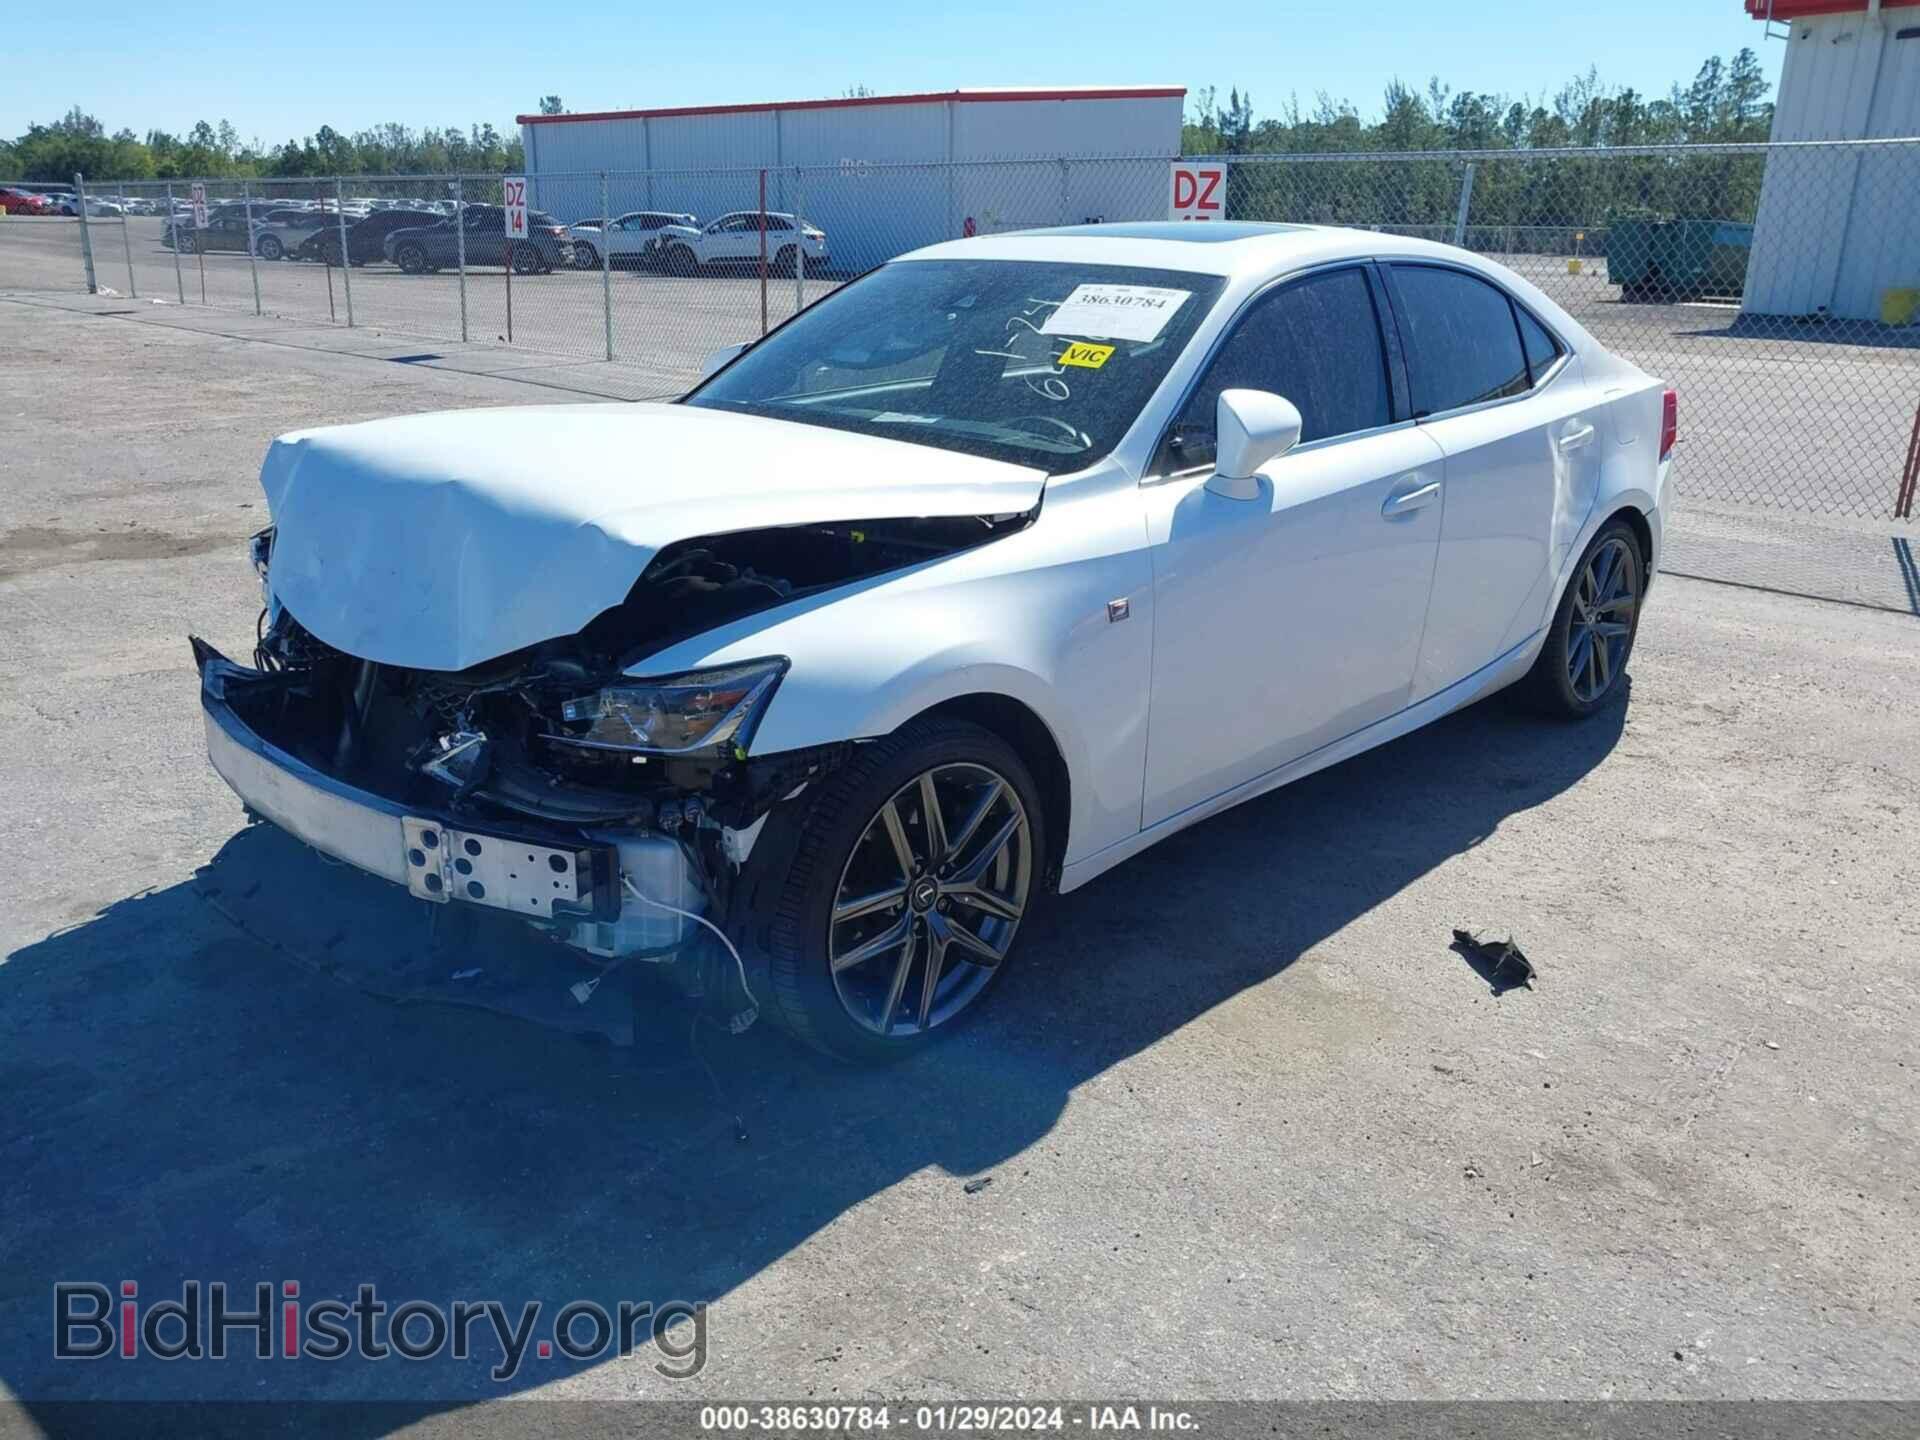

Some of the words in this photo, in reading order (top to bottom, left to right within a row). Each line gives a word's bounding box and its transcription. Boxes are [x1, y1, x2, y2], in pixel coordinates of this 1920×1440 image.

[506, 182, 525, 206] DZ
[1174, 170, 1221, 210] DZ
[511, 209, 523, 233] 14
[1078, 294, 1168, 309] 38630784
